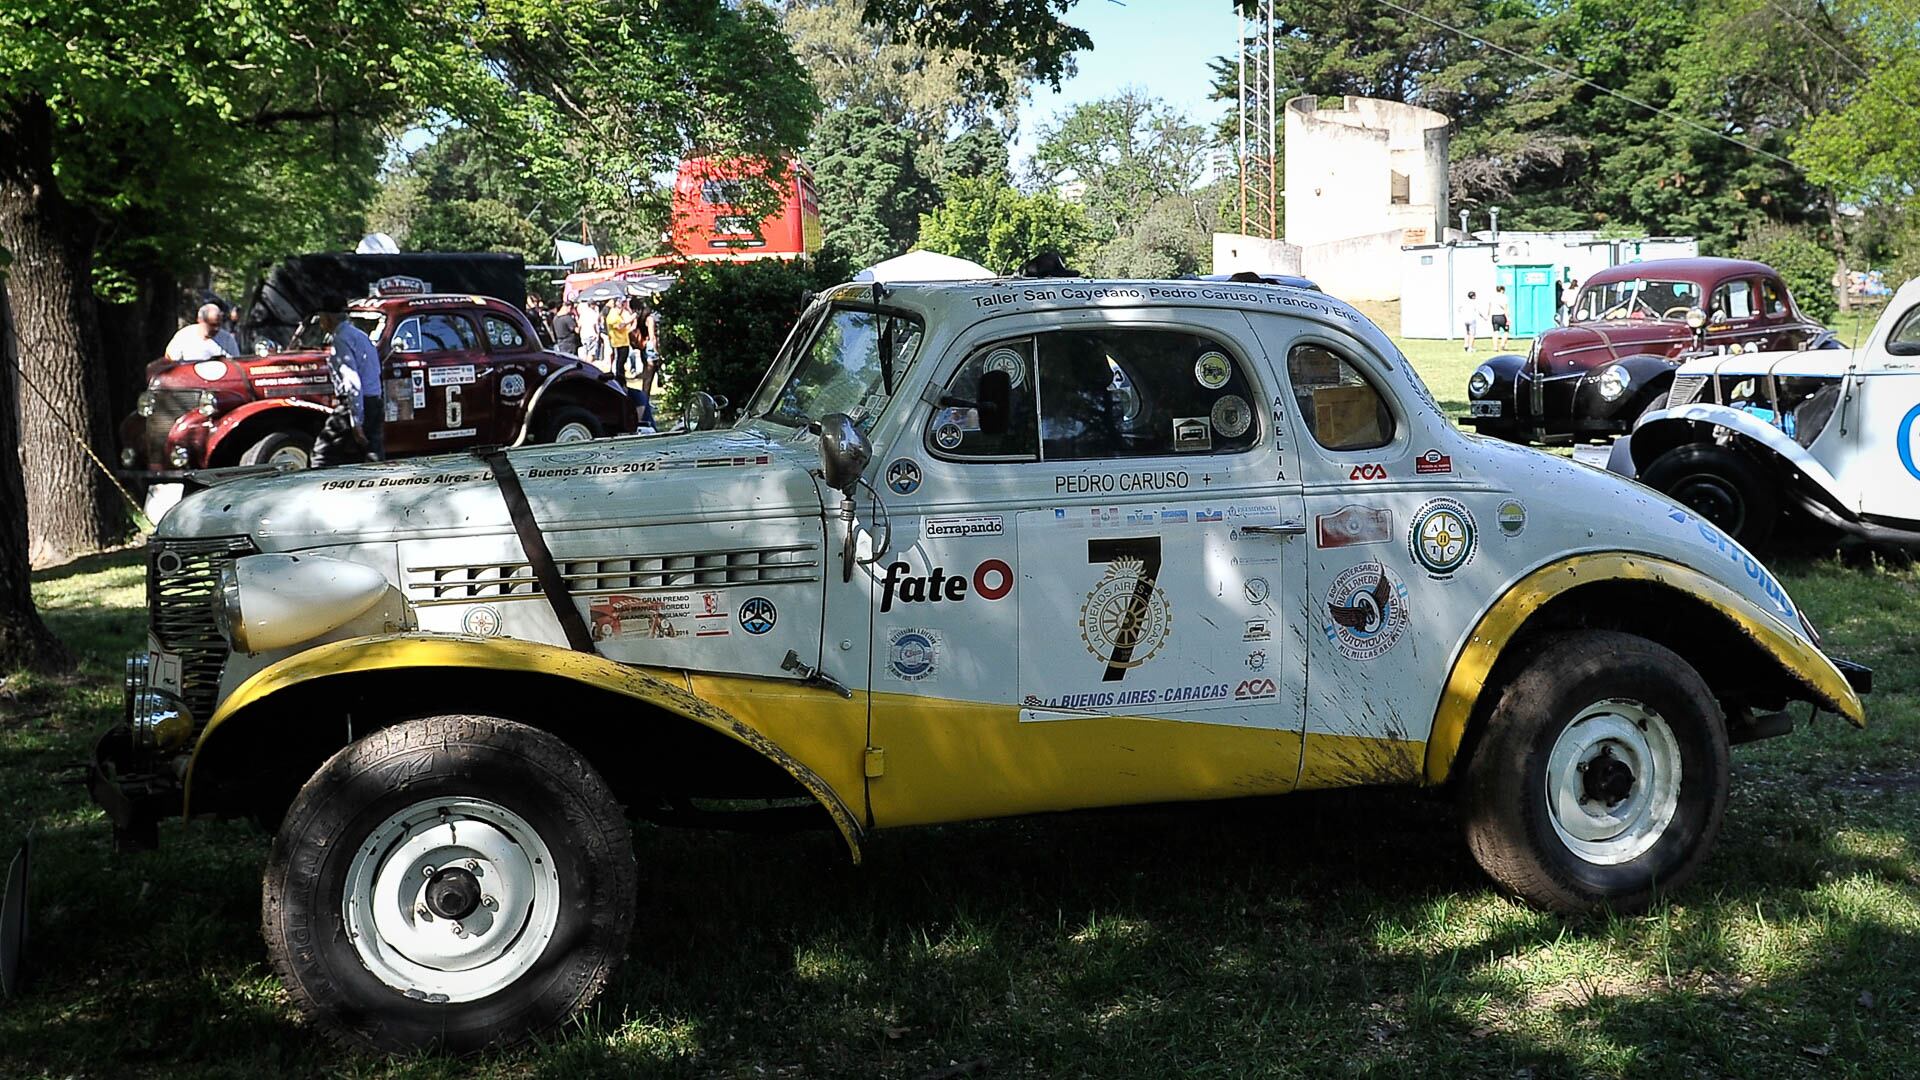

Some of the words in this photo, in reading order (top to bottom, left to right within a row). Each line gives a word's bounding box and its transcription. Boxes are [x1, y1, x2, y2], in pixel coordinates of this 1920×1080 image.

[972, 292, 1018, 308] Taller
[1023, 289, 1057, 300] San
[1061, 288, 1145, 301] Cayetano,
[1149, 287, 1197, 299] Pedro
[1201, 289, 1264, 305] Caruso,
[1266, 294, 1318, 310] Franco
[1321, 306, 1329, 315] y
[1332, 307, 1359, 323] Eric
[446, 385, 461, 428] 6
[321, 480, 354, 491] 1940
[358, 479, 375, 488] La
[380, 477, 430, 487] Buenos
[433, 473, 470, 485] Aires
[527, 466, 579, 478] Buenos
[583, 465, 618, 475] Aires
[622, 462, 656, 473] 2012
[1055, 475, 1115, 493] PEDRO
[1119, 472, 1189, 491] CARUSO
[927, 521, 1002, 536] derrapando
[880, 561, 968, 613] fate
[1336, 566, 1380, 587] ANIVERSARIO
[1088, 536, 1161, 682] 7
[1088, 588, 1112, 632] BUENOS
[1114, 582, 1145, 594] AIRES
[1147, 593, 1162, 646] CARACAS
[1338, 626, 1390, 649] AUTOMOVIL
[1350, 649, 1378, 659] MILLAS
[1061, 693, 1118, 707] BUENOS
